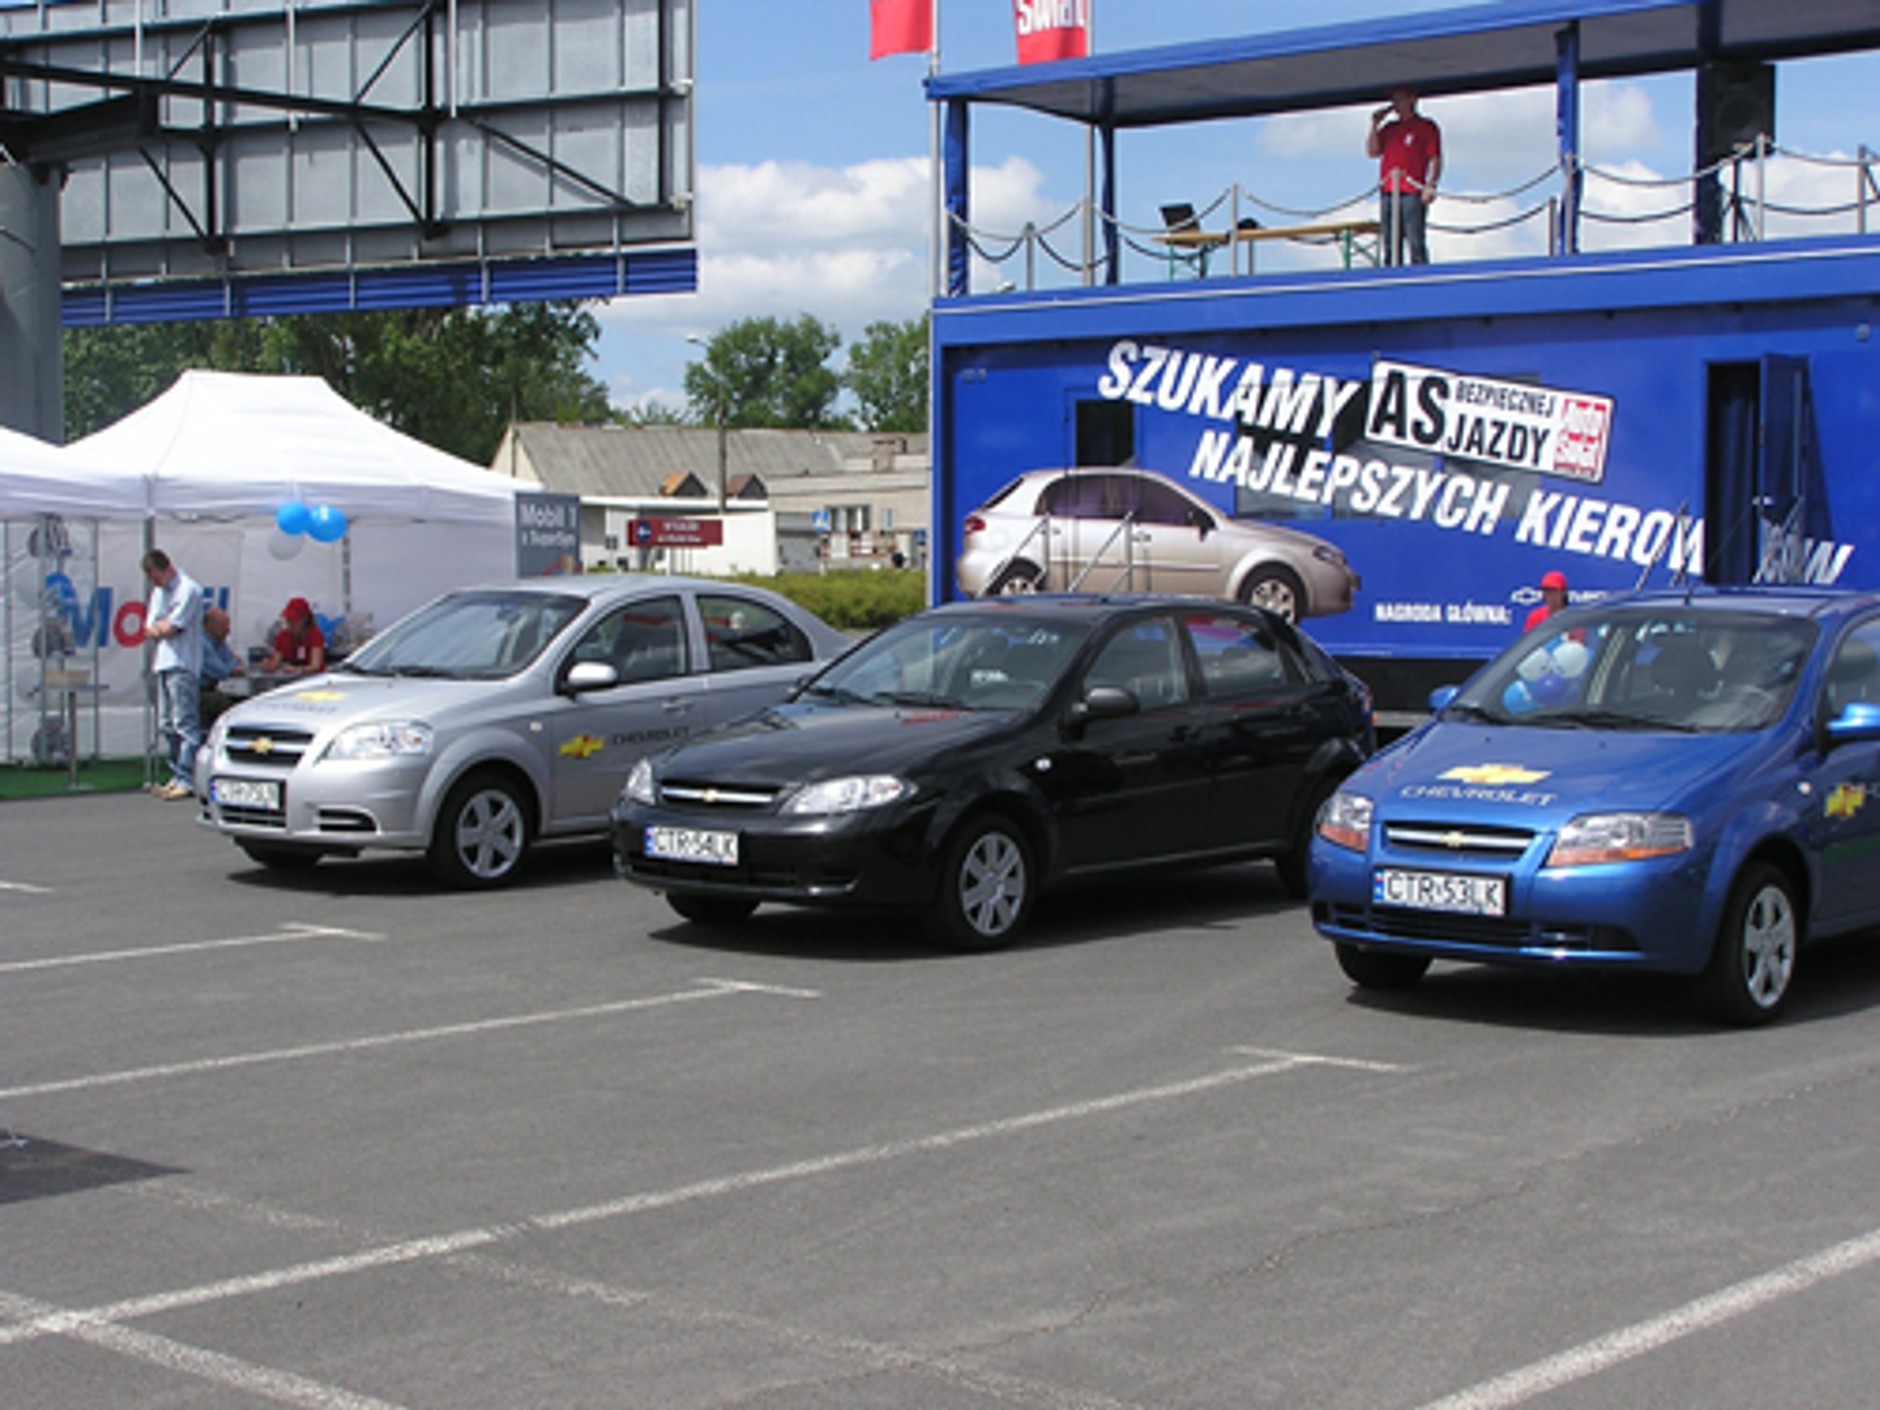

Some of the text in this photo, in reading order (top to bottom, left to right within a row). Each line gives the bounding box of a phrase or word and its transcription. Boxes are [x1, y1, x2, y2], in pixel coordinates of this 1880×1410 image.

[1098, 340, 1449, 446] SZUKAMY AS
[1455, 379, 1557, 418] BEZPIECZNEJ
[1447, 413, 1551, 467] JAZDY
[1189, 429, 1510, 536] NAJLEPSZYCH
[1375, 604, 1442, 622] NAGRODA
[1400, 785, 1558, 807] CHEVROLET
